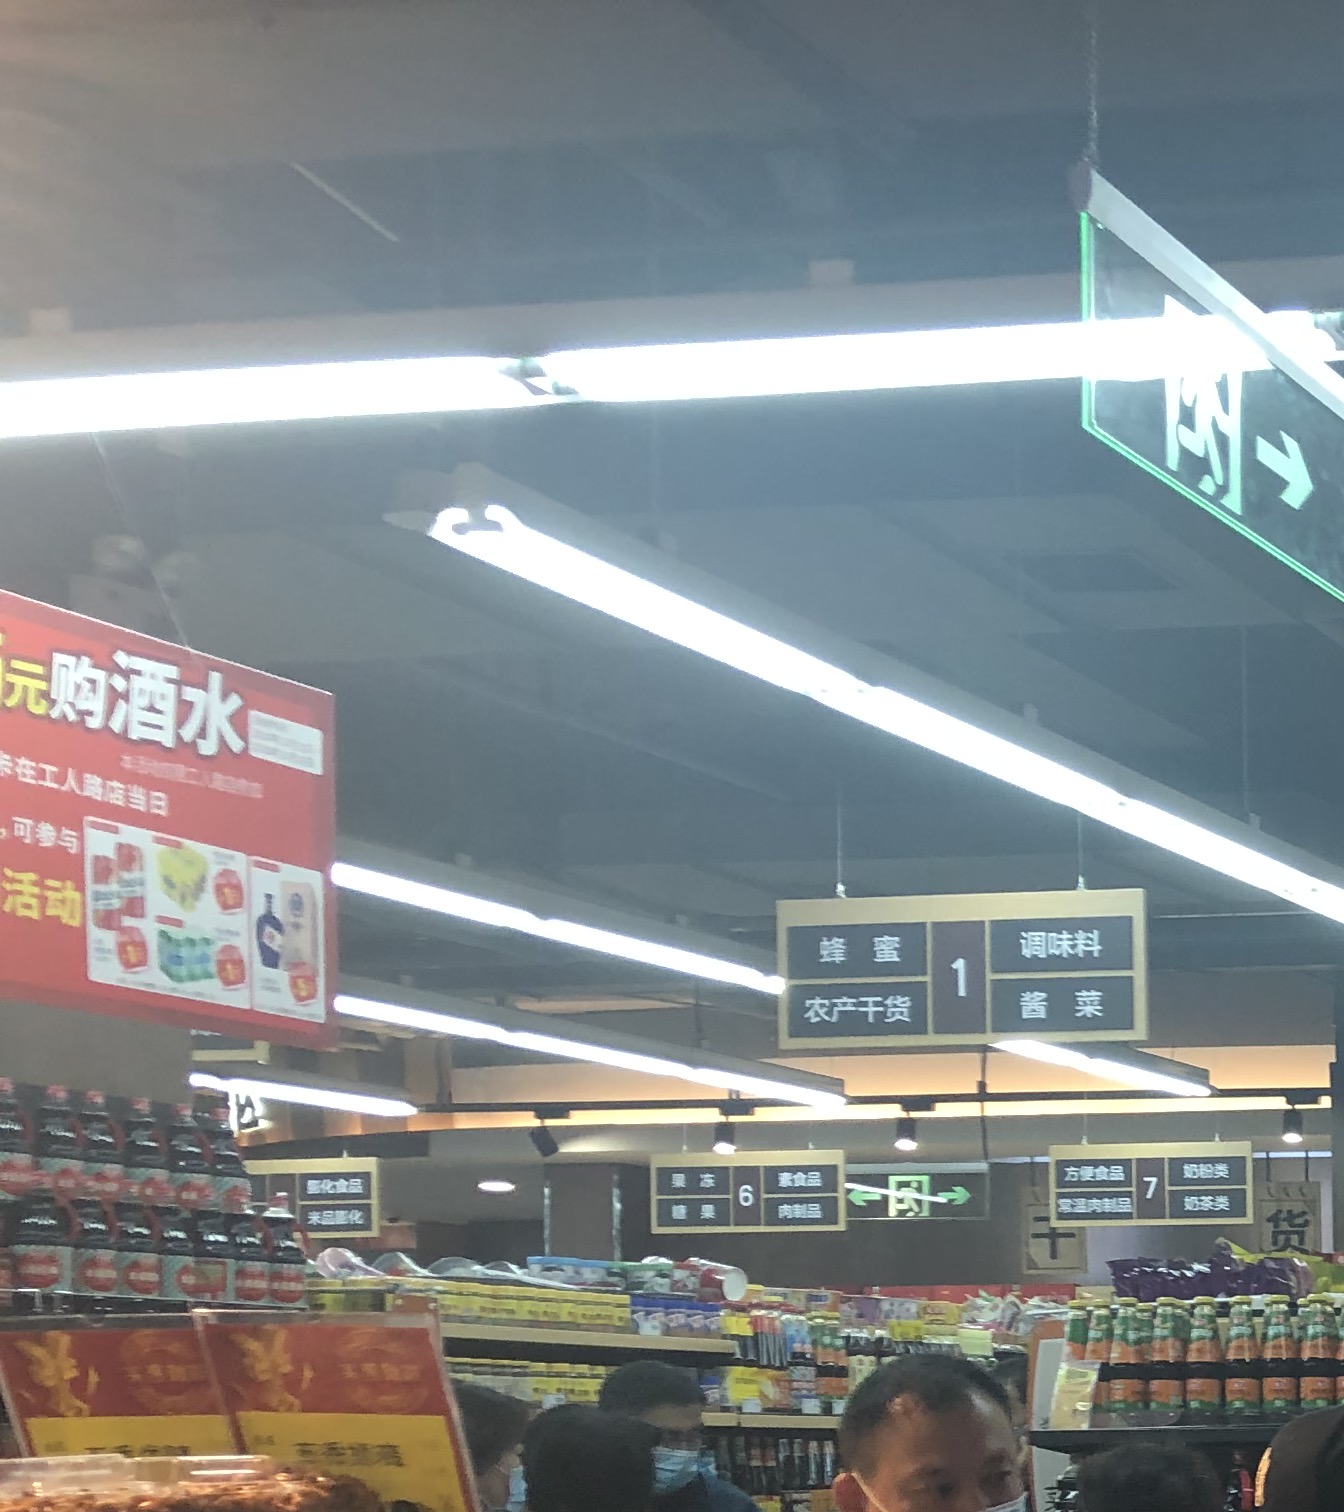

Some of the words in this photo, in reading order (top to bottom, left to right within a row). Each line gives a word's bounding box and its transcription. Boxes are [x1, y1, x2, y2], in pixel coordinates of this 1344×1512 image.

[0, 650, 246, 756] 元购酒水
[819, 936, 901, 964] 蜂蜜
[1020, 930, 1102, 959] 调味料
[951, 958, 967, 997] 1
[804, 996, 912, 1023] 农产干货
[1020, 990, 1103, 1020] 酱菜
[1064, 1165, 1125, 1181] 方便食品
[1183, 1163, 1230, 1179] 奶粉类
[738, 1185, 754, 1206] 6
[1143, 1177, 1158, 1199] 7
[778, 1203, 822, 1219] 肉制品
[1183, 1195, 1230, 1211] 奶茶类
[1267, 1208, 1310, 1253] 货
